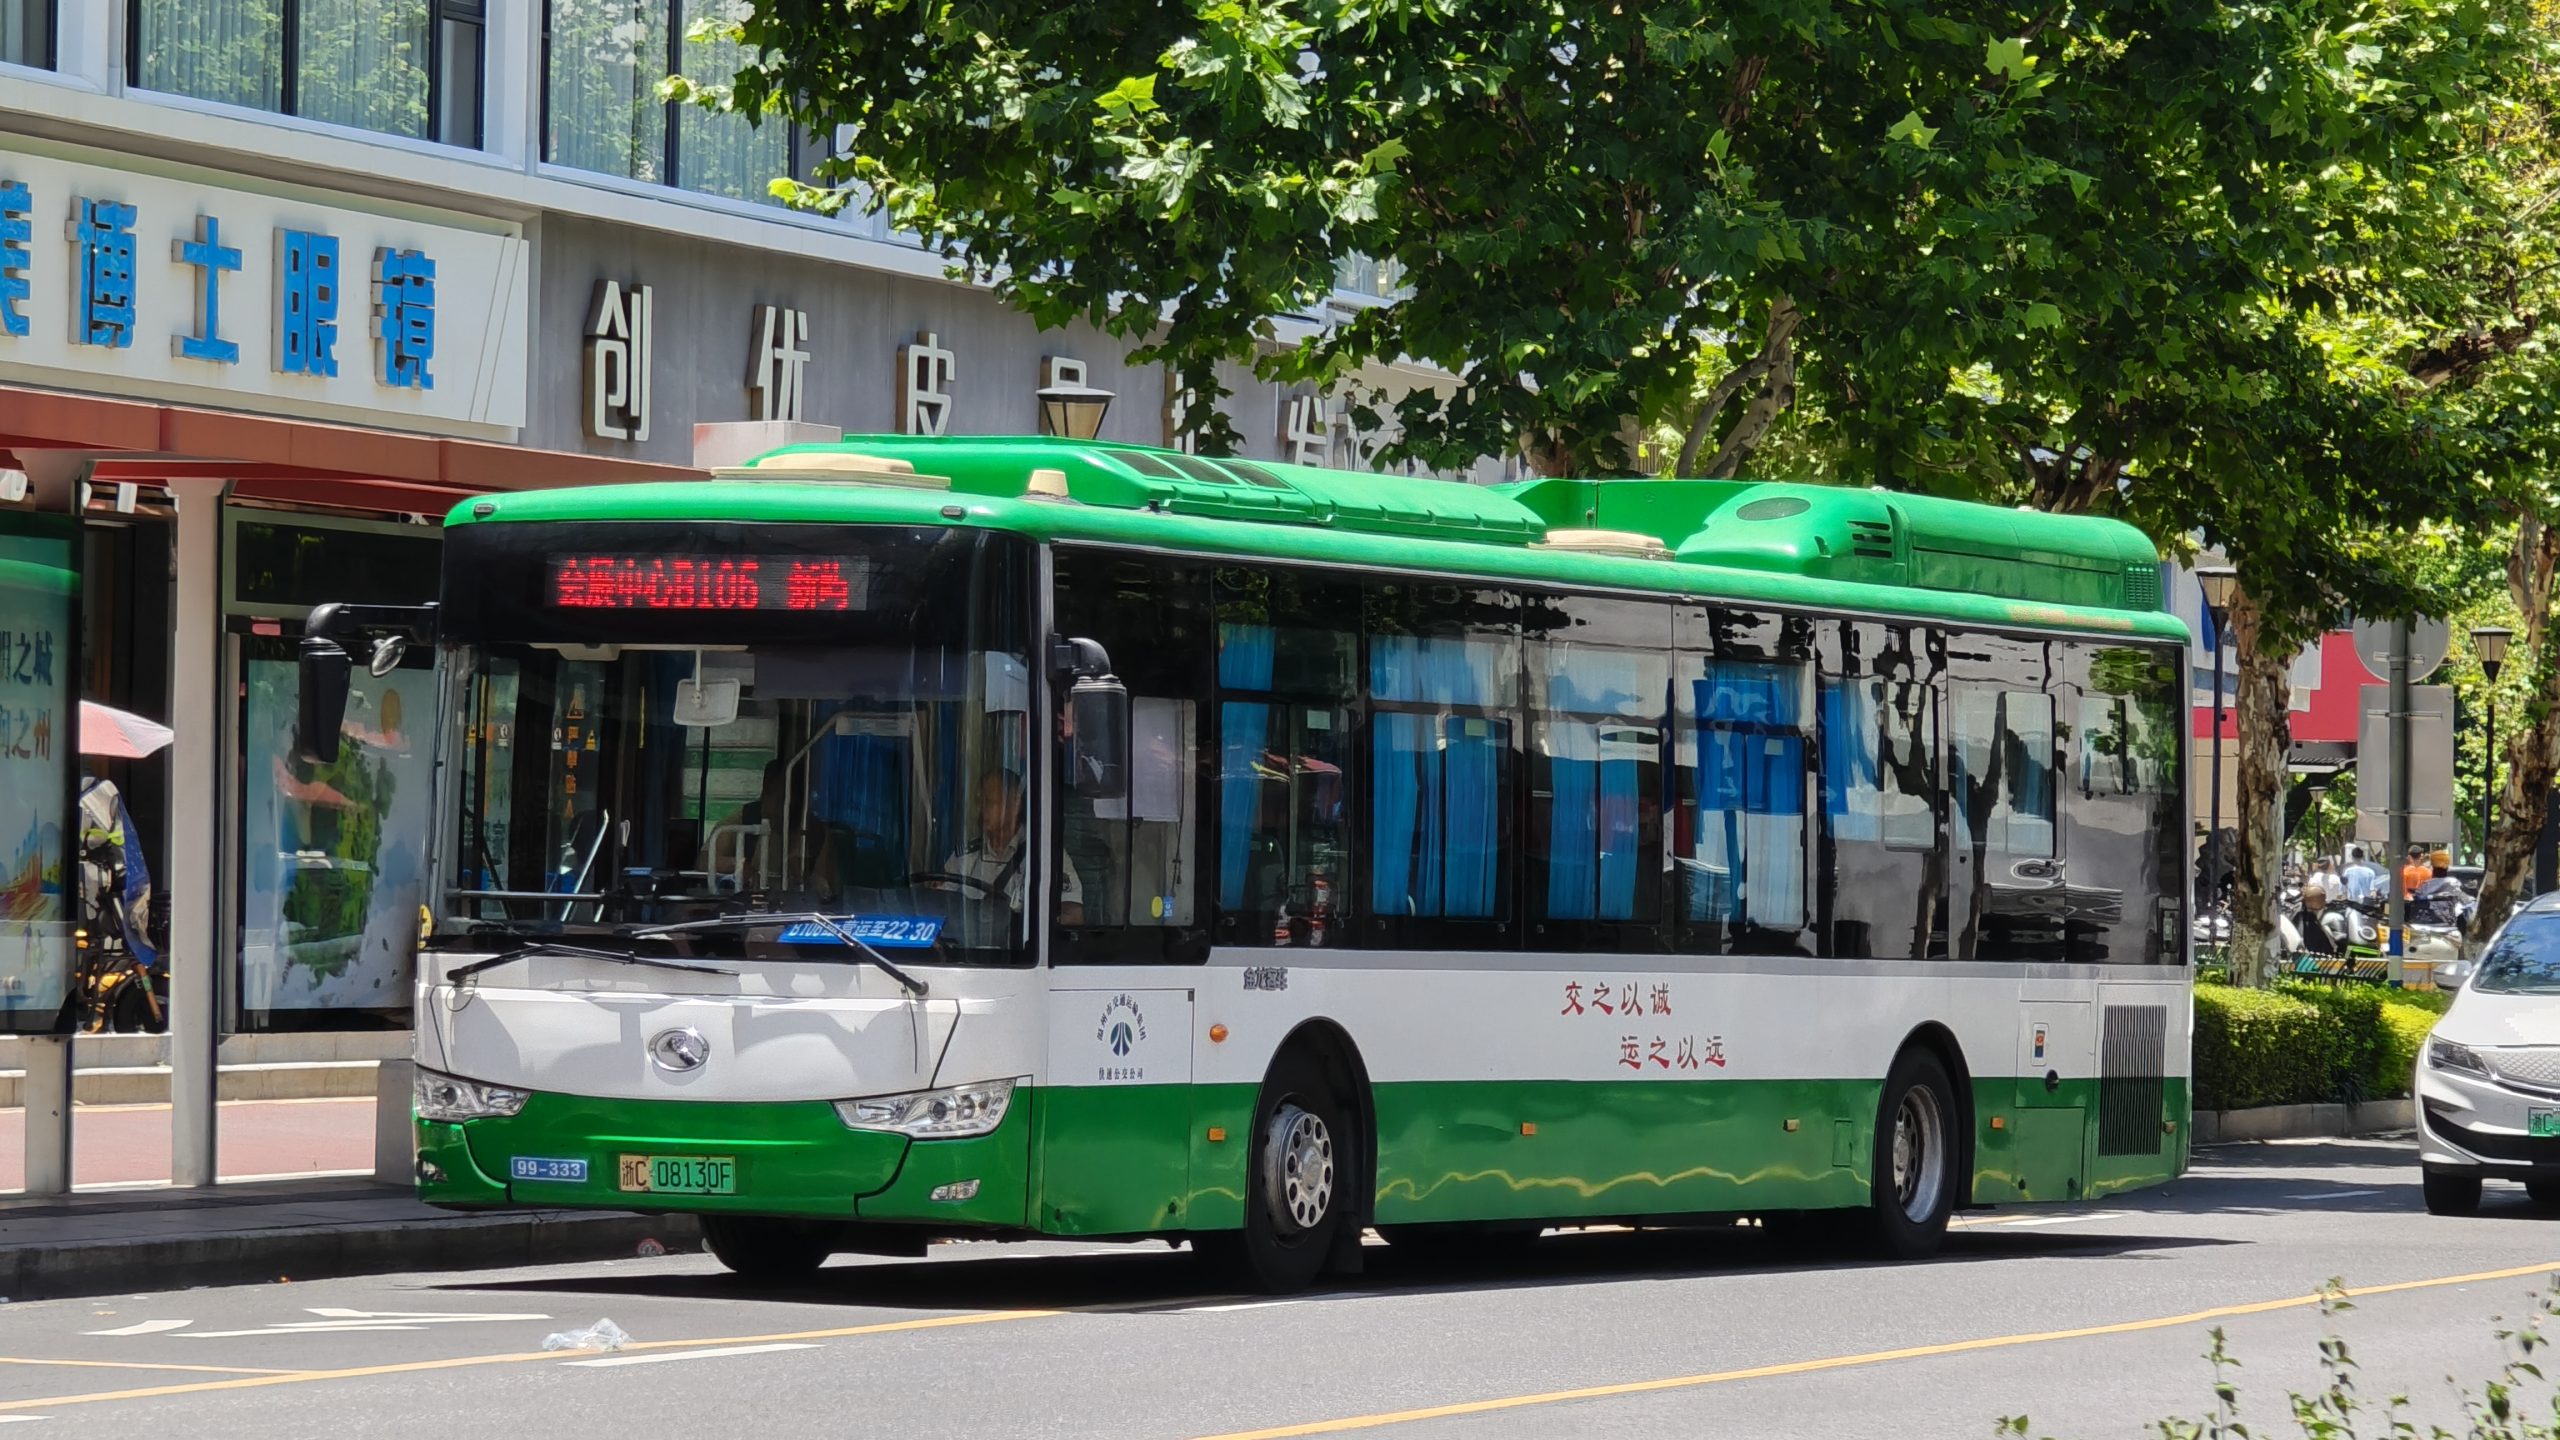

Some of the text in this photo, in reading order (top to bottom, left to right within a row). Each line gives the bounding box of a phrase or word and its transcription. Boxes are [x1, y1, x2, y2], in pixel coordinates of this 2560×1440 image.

[1560, 980, 1672, 1017] 交之以诚
[1618, 1034, 1727, 1071] 运之以远
[1098, 1066, 1144, 1082] 快速公交公司
[517, 1160, 582, 1178] 99-333
